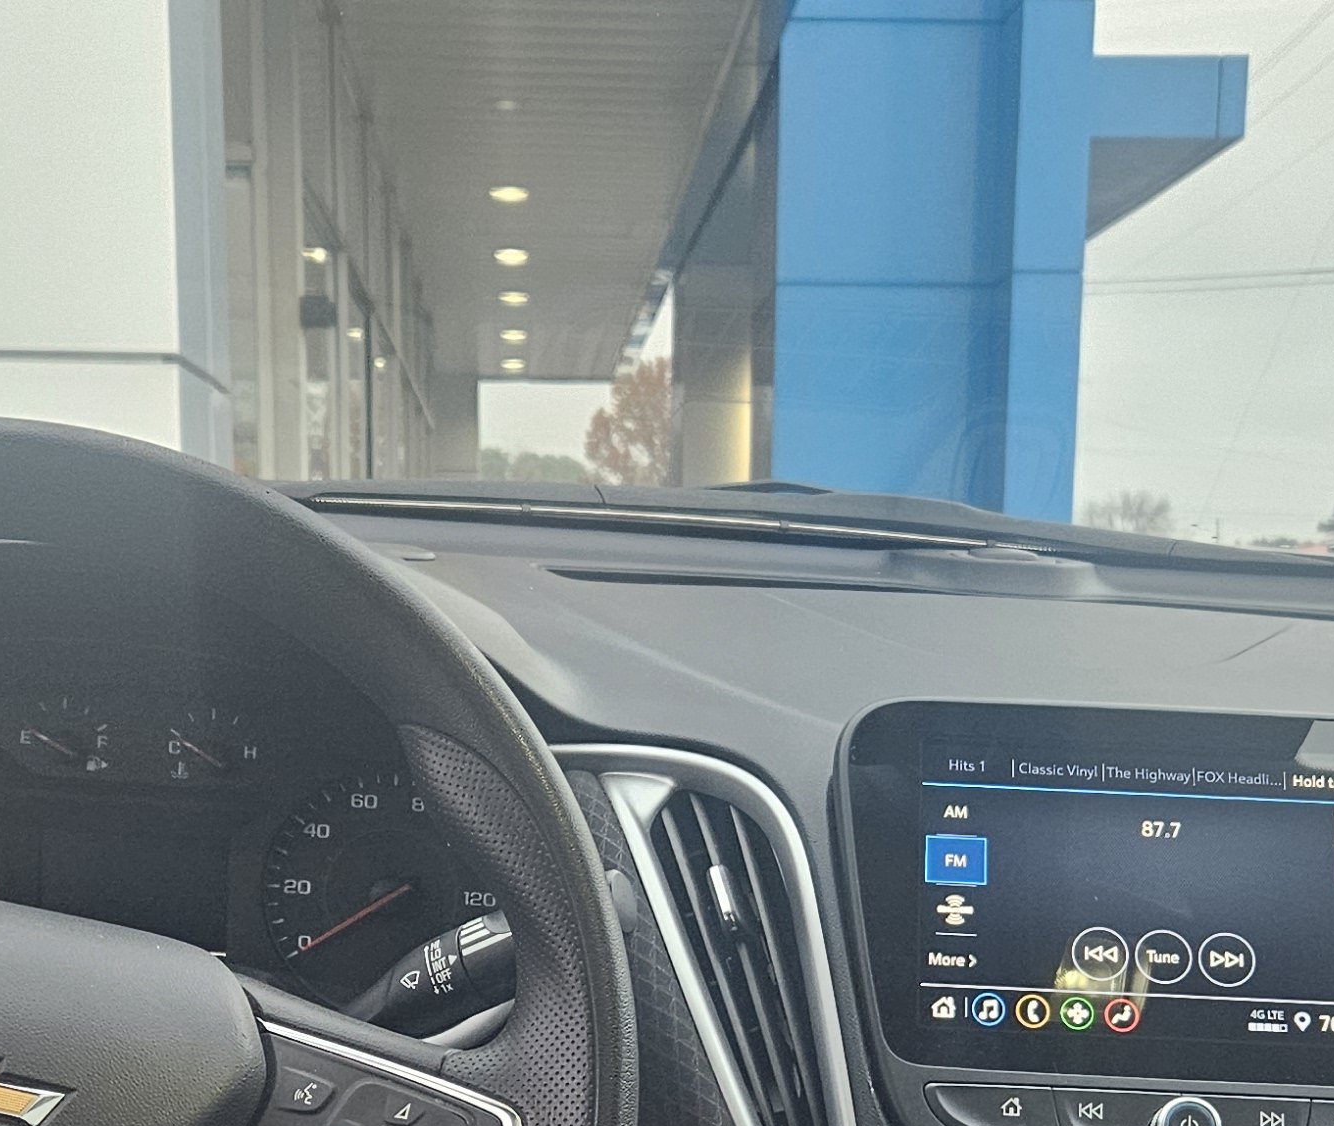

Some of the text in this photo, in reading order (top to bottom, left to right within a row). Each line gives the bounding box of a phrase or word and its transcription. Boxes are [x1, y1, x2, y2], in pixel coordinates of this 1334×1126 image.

[19, 729, 31, 745] E
[97, 735, 108, 749] F
[168, 740, 181, 755] C
[243, 746, 257, 759] H
[948, 759, 986, 772] Hits 1
[1019, 762, 1098, 780] Classic Vinyl
[1107, 766, 1191, 786] The Highway
[1197, 771, 1282, 786] FOX Headli...
[1292, 774, 1325, 789] Hold
[350, 793, 378, 809] 60
[943, 805, 968, 819] AM
[303, 823, 330, 839] 40
[1141, 820, 1181, 838] 87.7
[944, 853, 967, 868] FM
[283, 879, 311, 895] 20
[463, 891, 496, 907] 120
[298, 935, 312, 950] 0
[430, 948, 442, 962] LO
[928, 952, 966, 967] More
[1146, 949, 1180, 964] Tune
[432, 956, 447, 973] INT
[435, 967, 452, 984] OFF
[440, 983, 454, 993] 1x
[1249, 1009, 1284, 1020] 4G LTE
